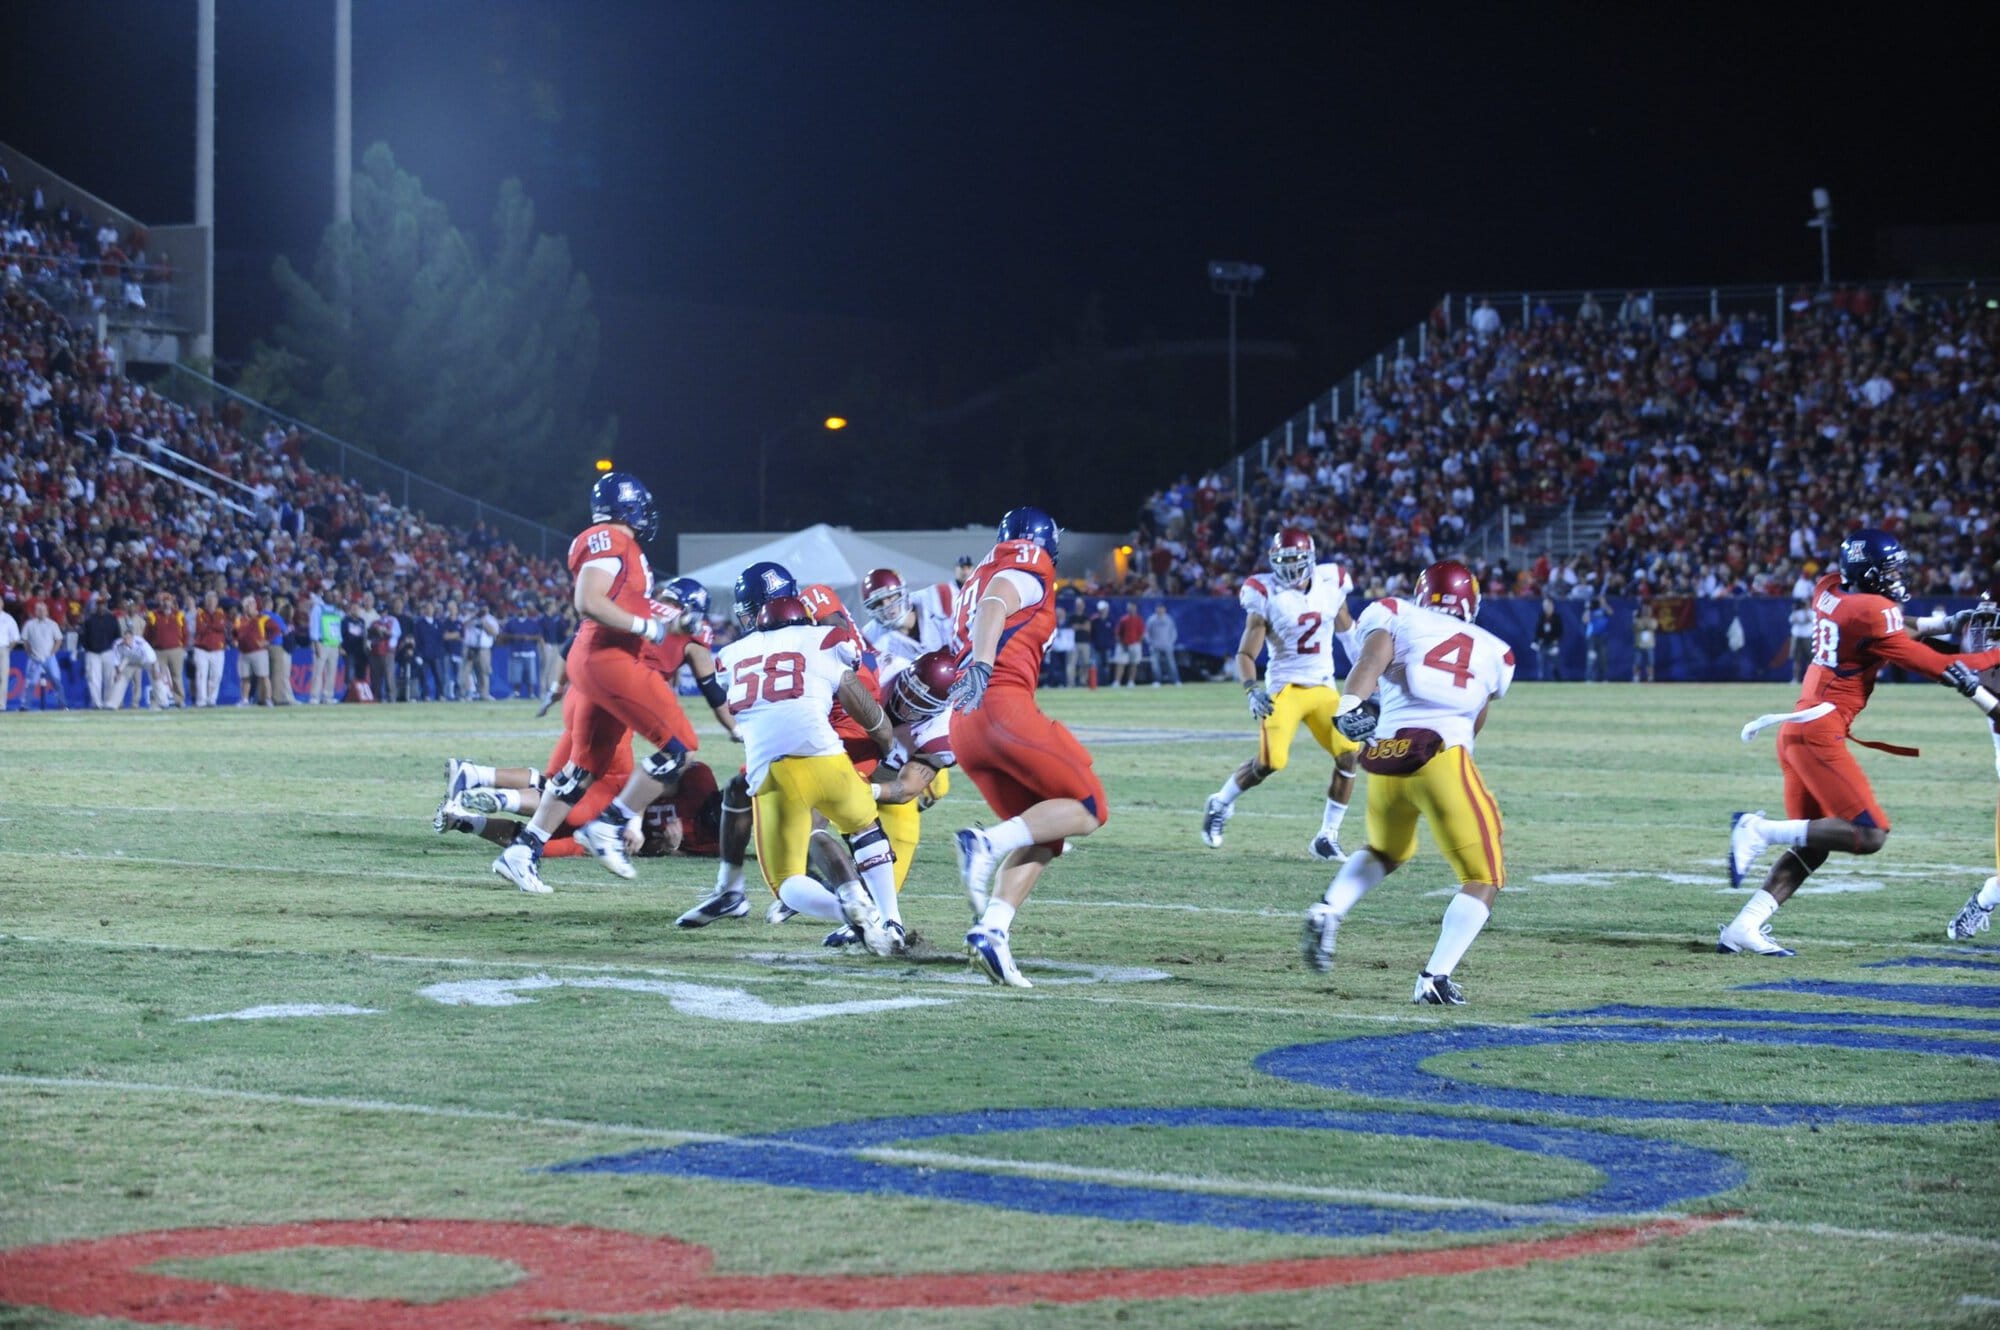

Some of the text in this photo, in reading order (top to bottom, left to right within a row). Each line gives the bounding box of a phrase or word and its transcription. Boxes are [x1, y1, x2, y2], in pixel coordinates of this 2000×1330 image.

[1014, 543, 1041, 564] 37
[761, 569, 790, 594] A
[1296, 611, 1322, 655] 2
[1423, 631, 1475, 690] 4
[727, 651, 806, 716] 58
[1367, 737, 1412, 761] USC
